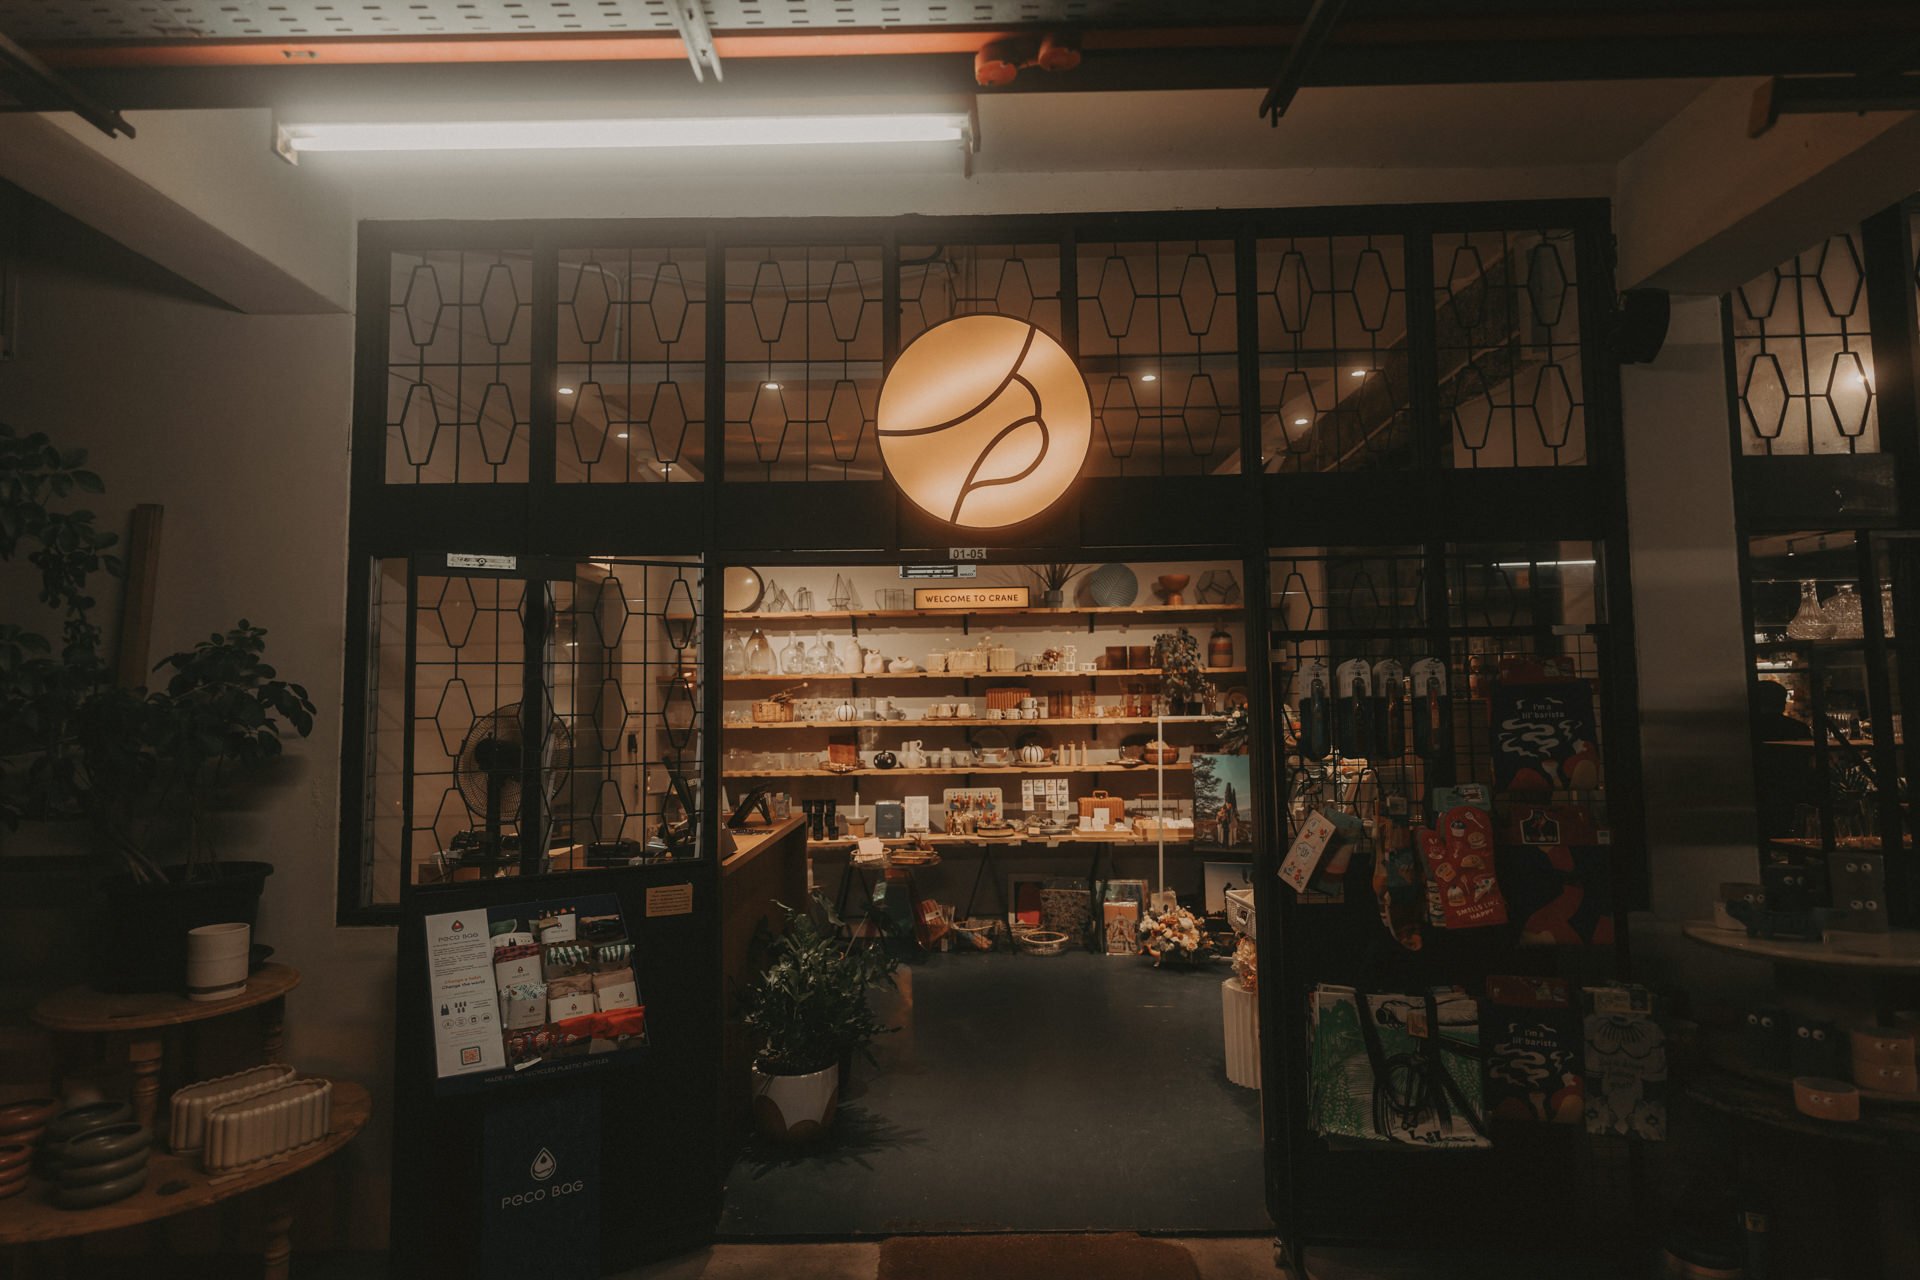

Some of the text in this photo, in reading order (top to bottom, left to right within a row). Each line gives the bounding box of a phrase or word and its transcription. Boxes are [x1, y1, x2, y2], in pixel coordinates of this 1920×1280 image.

[953, 549, 984, 559] 01-05
[925, 594, 1019, 603] WELCOME TO CRANE
[1534, 711, 1566, 719] barista
[1456, 903, 1483, 917] SMELLS
[1470, 908, 1494, 921] HAPPY
